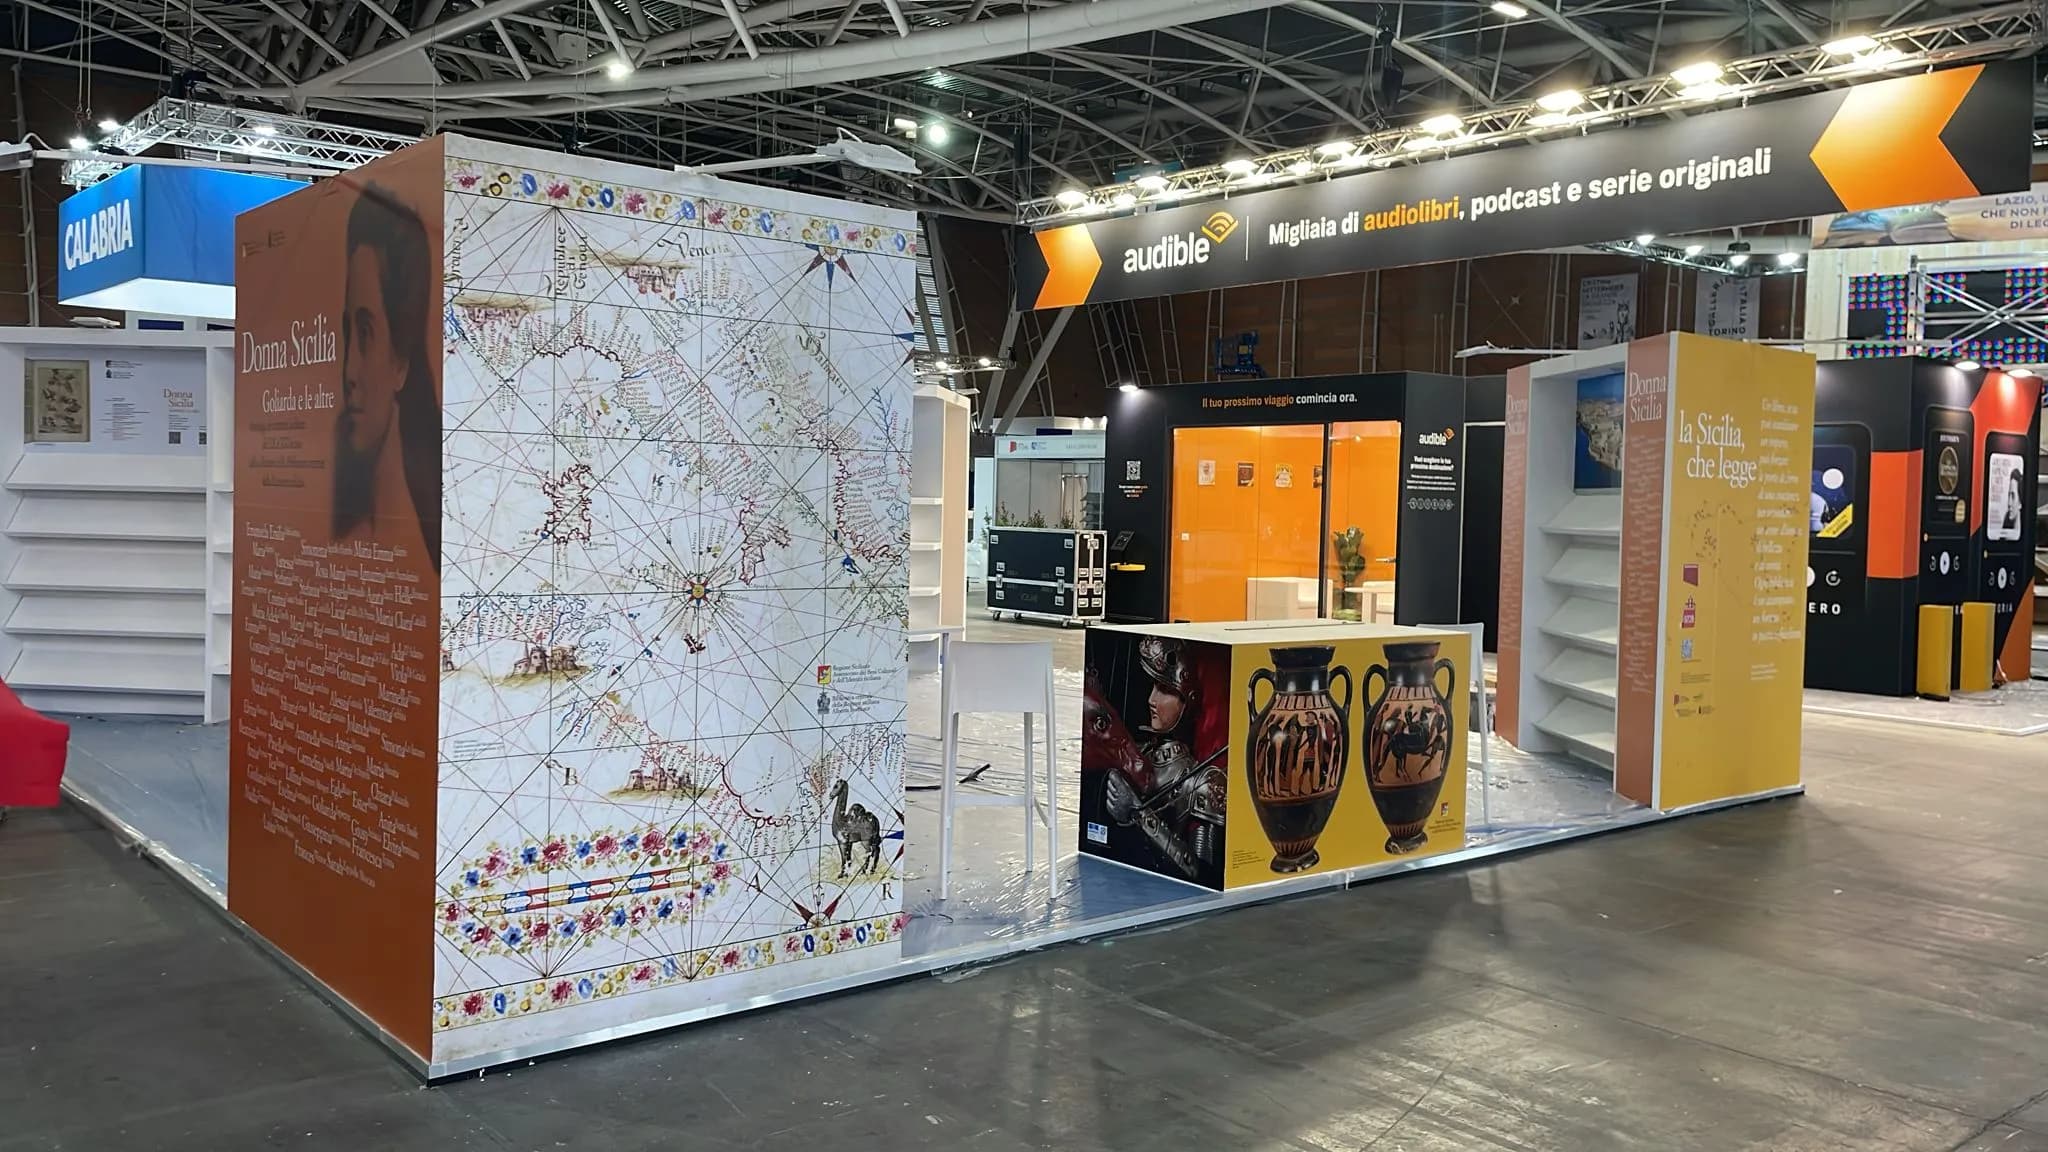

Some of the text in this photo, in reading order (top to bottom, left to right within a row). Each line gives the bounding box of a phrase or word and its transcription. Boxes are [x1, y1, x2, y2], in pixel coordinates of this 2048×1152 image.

[1123, 147, 1772, 273] audible Migliaia di audiolibri, podcast e serie originali
[1995, 195, 2038, 206] LAZIO,
[1981, 209, 2006, 219] CHE
[2011, 207, 2039, 217] NON
[2011, 220, 2023, 229] DI
[64, 199, 134, 271] CALABRIA
[242, 313, 336, 373] Donna Sicilia
[1628, 371, 1667, 398] Donna
[297, 394, 304, 410] e
[304, 384, 312, 410] le
[314, 383, 335, 409] altre
[1202, 393, 1358, 409] Il tuo prossimo viaggio comincia ora.
[1630, 395, 1663, 423] Sicilia
[1419, 431, 1447, 446] audible
[1679, 409, 1693, 444] la
[1696, 411, 1745, 452] Sicilia,
[1687, 445, 1758, 489] che legge
[1808, 602, 1841, 615] ERO
[563, 767, 578, 786] B
[882, 882, 895, 901] R
